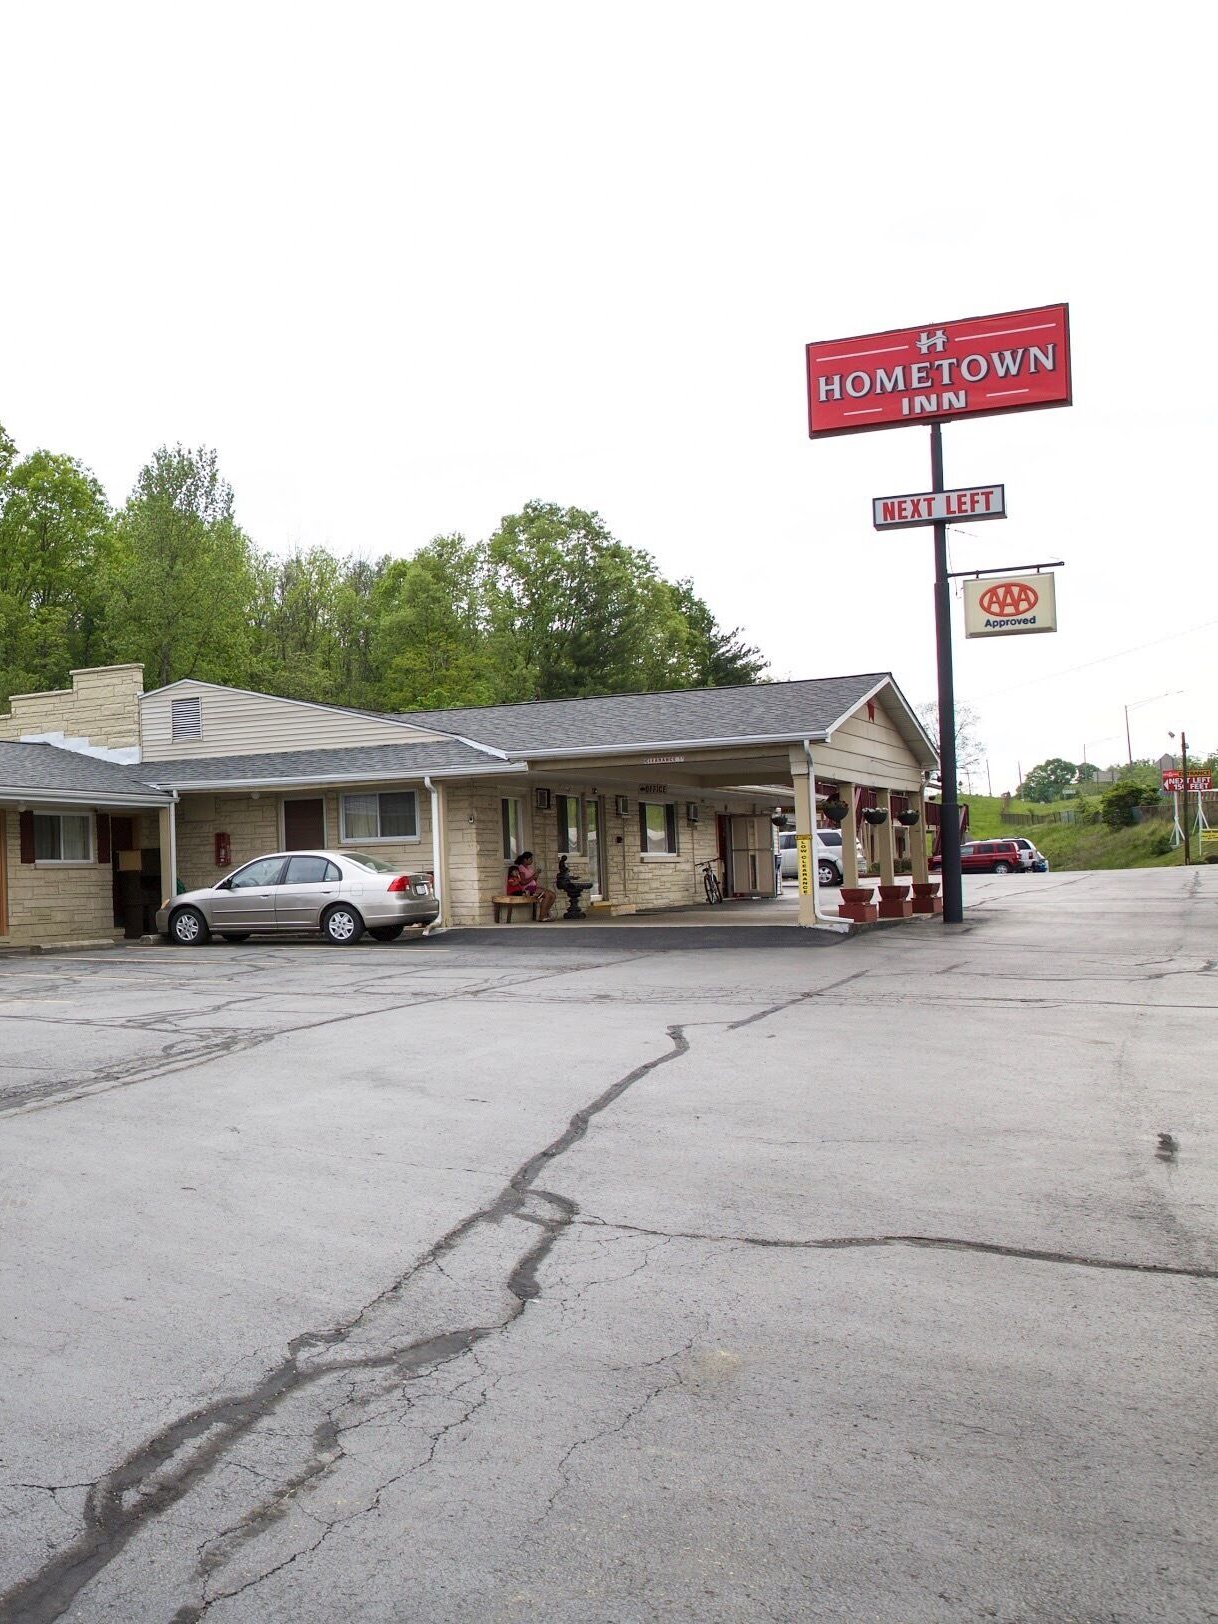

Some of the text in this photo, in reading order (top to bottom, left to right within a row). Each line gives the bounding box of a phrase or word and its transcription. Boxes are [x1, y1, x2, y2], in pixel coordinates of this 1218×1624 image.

[817, 343, 1055, 402] HOMETOWN
[901, 390, 967, 416] INN
[882, 491, 994, 522] NEXT LEFT
[986, 586, 1034, 615] AAA
[984, 615, 1037, 629] Approved
